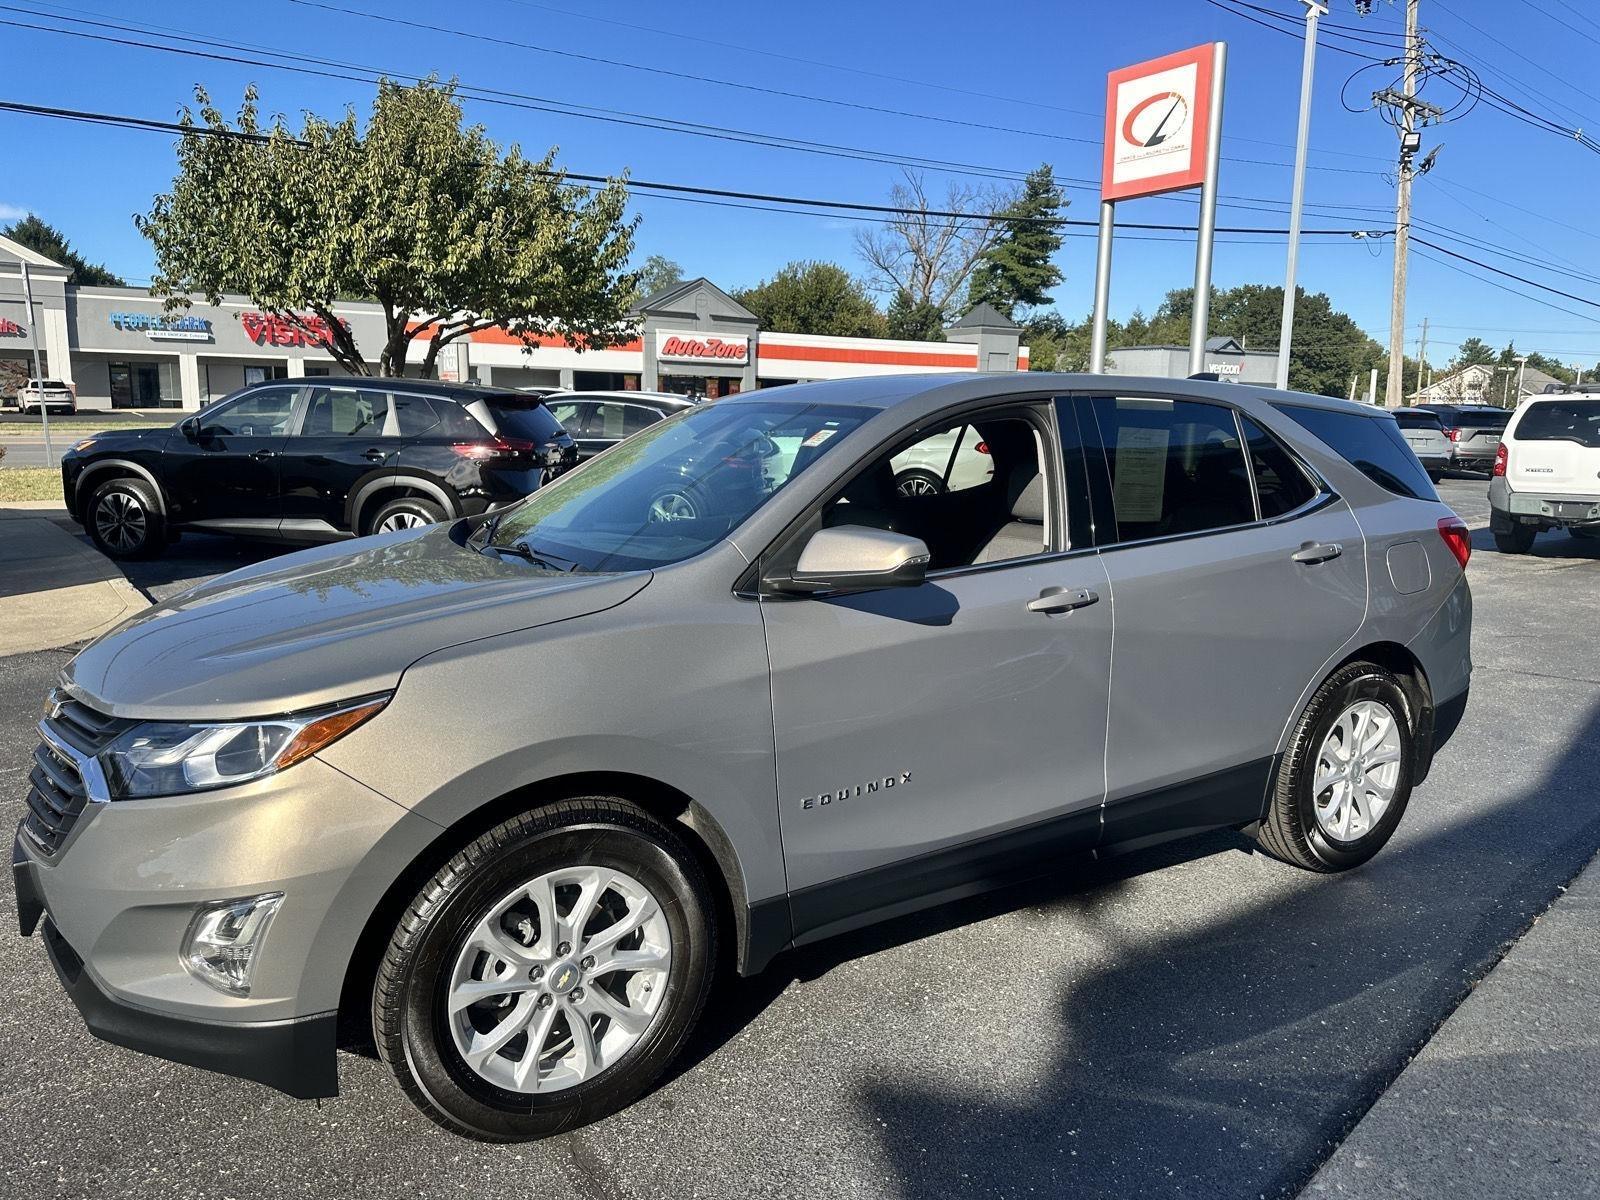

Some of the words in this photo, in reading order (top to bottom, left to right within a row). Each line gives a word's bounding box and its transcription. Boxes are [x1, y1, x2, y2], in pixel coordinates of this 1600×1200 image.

[661, 336, 748, 359] AutoZone
[1208, 361, 1240, 375] verizon
[800, 770, 912, 810] EQUINOX
